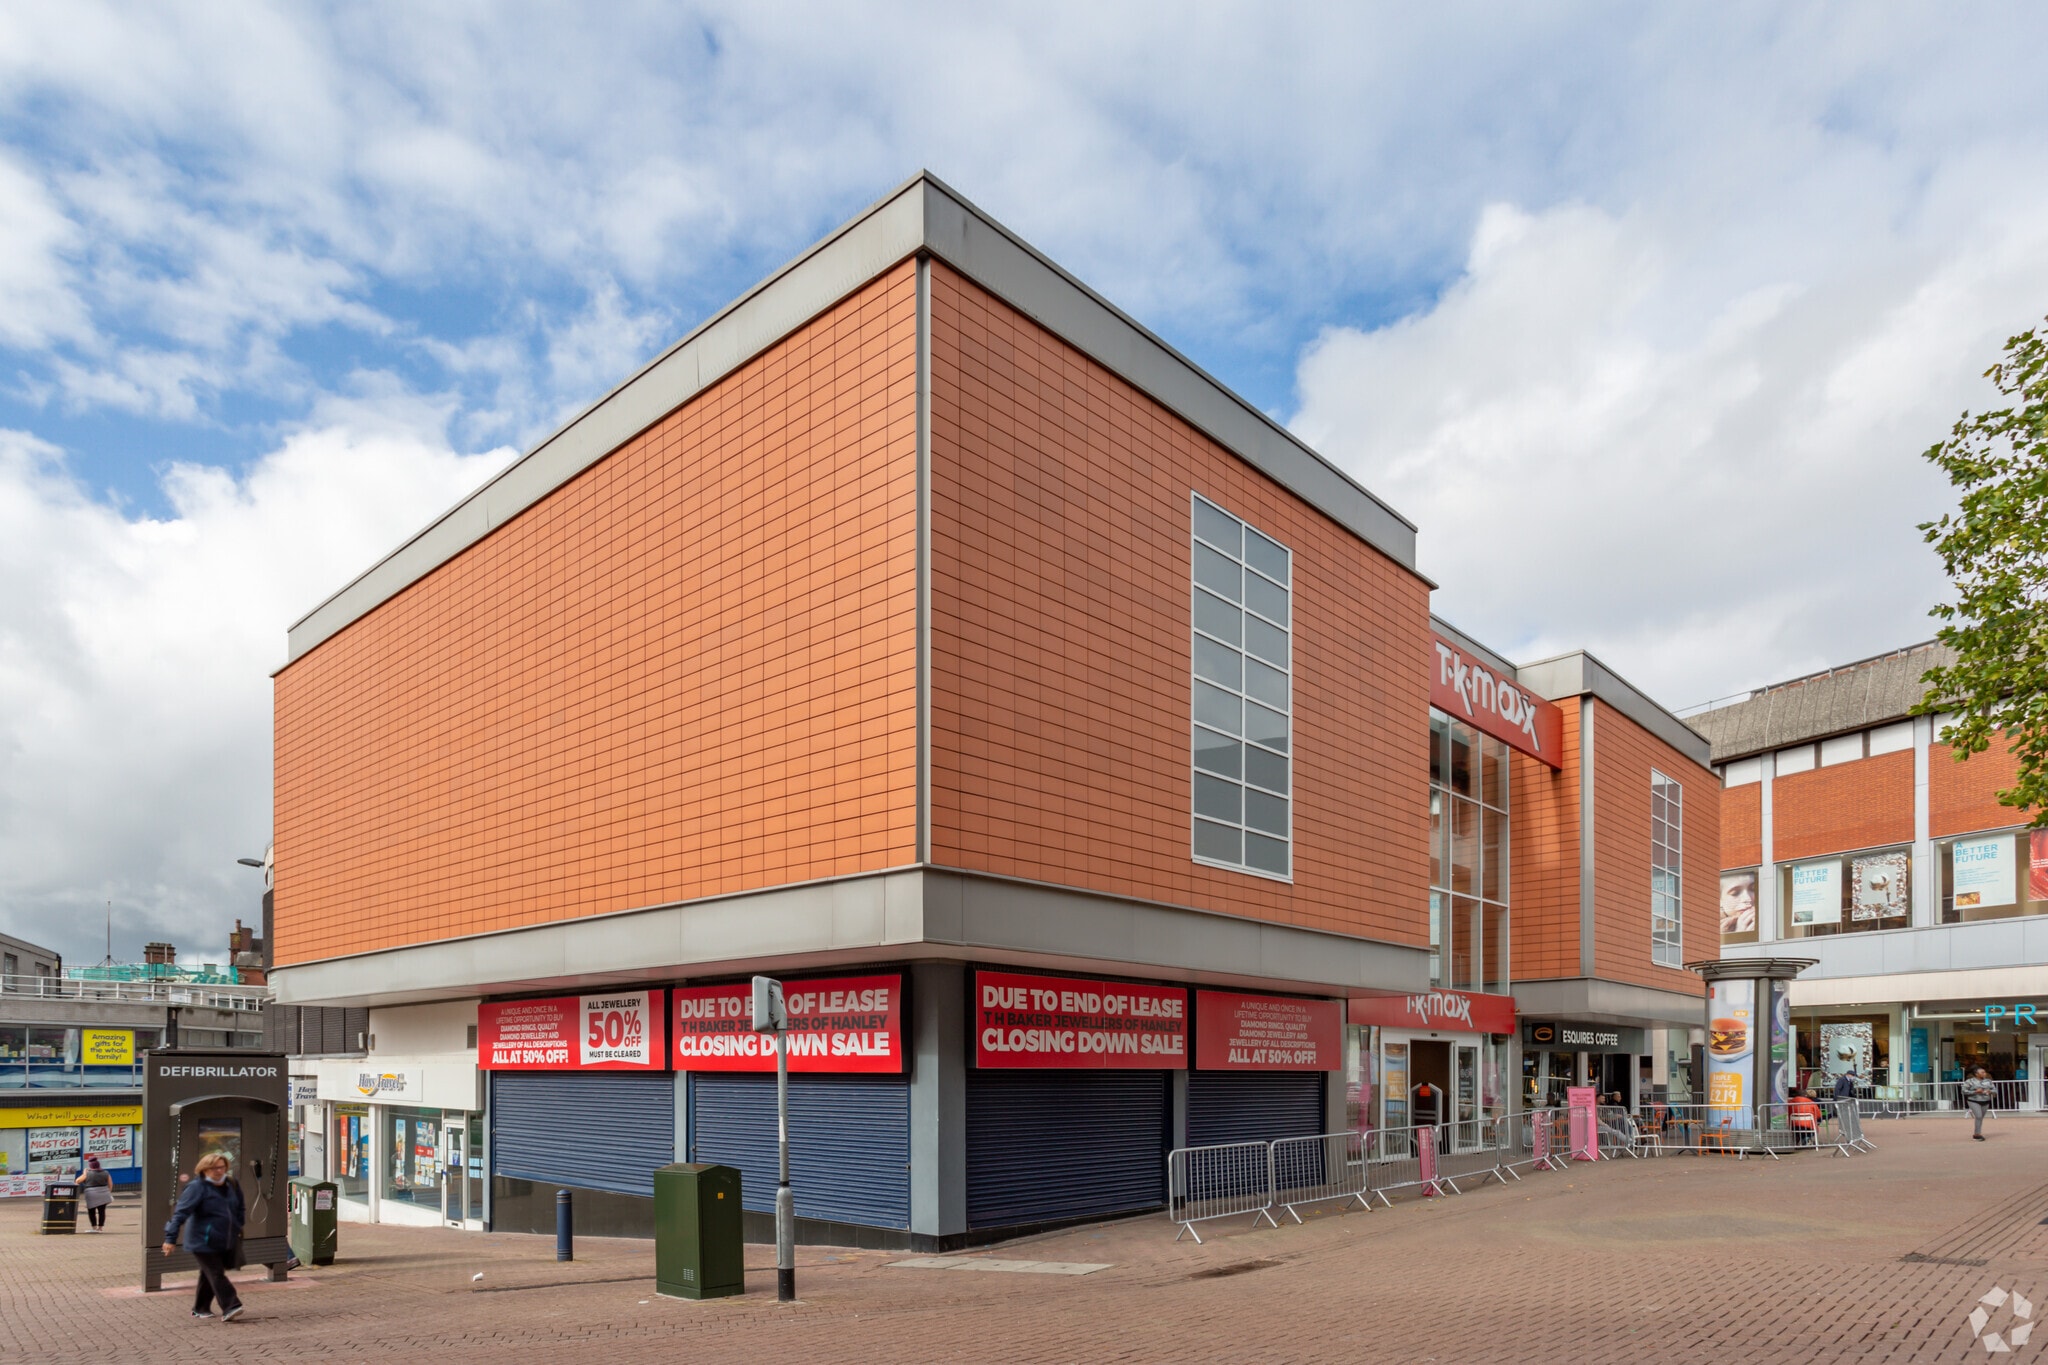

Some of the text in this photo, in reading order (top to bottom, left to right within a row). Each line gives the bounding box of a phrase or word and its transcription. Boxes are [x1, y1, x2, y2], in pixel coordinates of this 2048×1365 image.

[1955, 844, 1998, 856] BETTER
[1955, 851, 1997, 864] FUTURE
[1794, 868, 1828, 878] BETTER
[1794, 876, 1827, 885] FUTURE
[588, 998, 641, 1010] ALL JEWELLERY
[681, 998, 716, 1018] DUE
[718, 997, 742, 1017] TO
[788, 993, 816, 1014] OF
[820, 988, 888, 1013] LEASE
[983, 985, 1183, 1018] DUE TO END OF LEASE
[522, 1006, 532, 1014] AND
[1246, 1002, 1267, 1011] UNIQUE
[1268, 1003, 1280, 1011] AND
[1281, 1005, 1295, 1013] ONCE
[514, 1014, 546, 1023] OPPORTUNITY
[1234, 1010, 1257, 1019] LIFETIME
[1259, 1011, 1294, 1021] OPPORTUNITY
[537, 1023, 558, 1031] QUALITY
[681, 1015, 888, 1034] T H BAKER JEERS OF HANLEY
[984, 1012, 1182, 1033] T H BAKER JEWELLERS OF HANLEY
[1241, 1020, 1267, 1028] DIAMOND
[1285, 1022, 1307, 1031] QUALITY
[588, 1010, 642, 1048] 50%
[520, 1032, 548, 1040] JEWELLERY
[1267, 1031, 1296, 1039] JEWELLERY
[1297, 1032, 1308, 1040] AND
[1563, 1030, 1618, 1045] ESQUIRES COFFEE
[492, 1041, 516, 1049] JEWELLERY
[533, 1040, 568, 1048] DESCRIPTIONS
[624, 1036, 642, 1048] OFF
[680, 1034, 758, 1056] CLOSING
[832, 1032, 890, 1056] SALE
[982, 1028, 1184, 1055] CLOSING DOWN SALE
[1229, 1038, 1261, 1047] JEWELLERY
[1270, 1040, 1280, 1048] ALL
[1281, 1041, 1316, 1049] DESCRIPTIONS
[492, 1050, 569, 1064] ALL AT 50% OFF!
[589, 1050, 642, 1058] MUST BE CLEARED
[1228, 1048, 1316, 1064] ALL AT 50% OFF!
[160, 1066, 278, 1077] DEFIBRILLATOR
[358, 1074, 400, 1088] Hays Travel
[298, 1086, 317, 1094] Hays
[27, 1112, 52, 1120] What
[55, 1111, 71, 1119] will
[93, 1109, 137, 1118] discover?
[89, 1127, 127, 1139] SALE
[30, 1138, 79, 1149] MUST GO!
